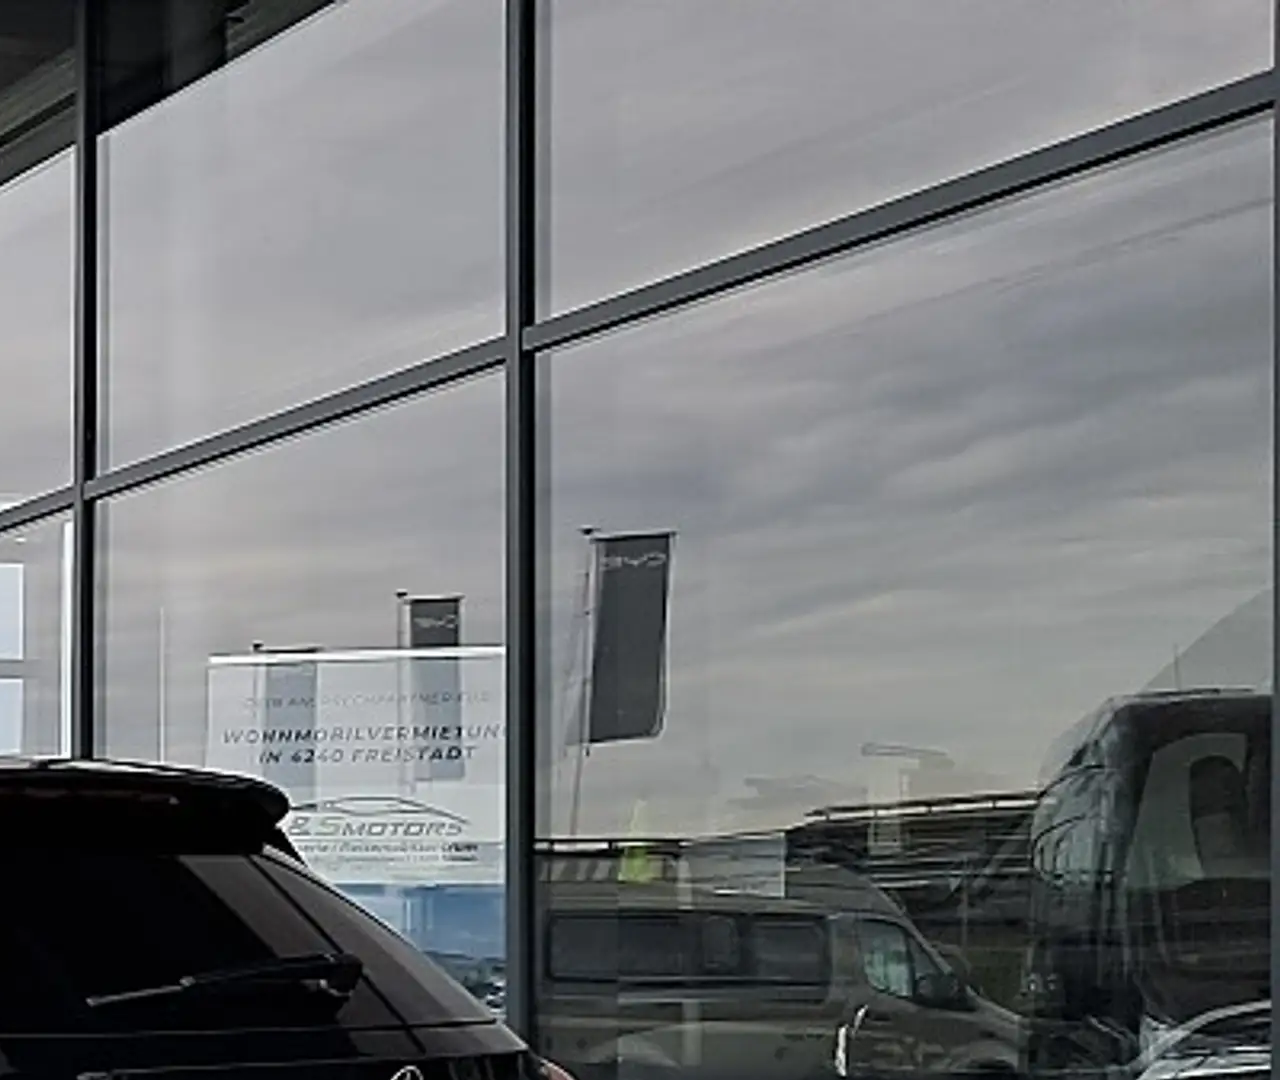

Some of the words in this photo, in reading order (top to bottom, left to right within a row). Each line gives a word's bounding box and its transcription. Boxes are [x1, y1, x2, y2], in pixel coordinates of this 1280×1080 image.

[222, 723, 506, 745] WOHNMOBILVERMIETUN
[259, 751, 282, 764] IN
[351, 745, 476, 763] FREISTADT
